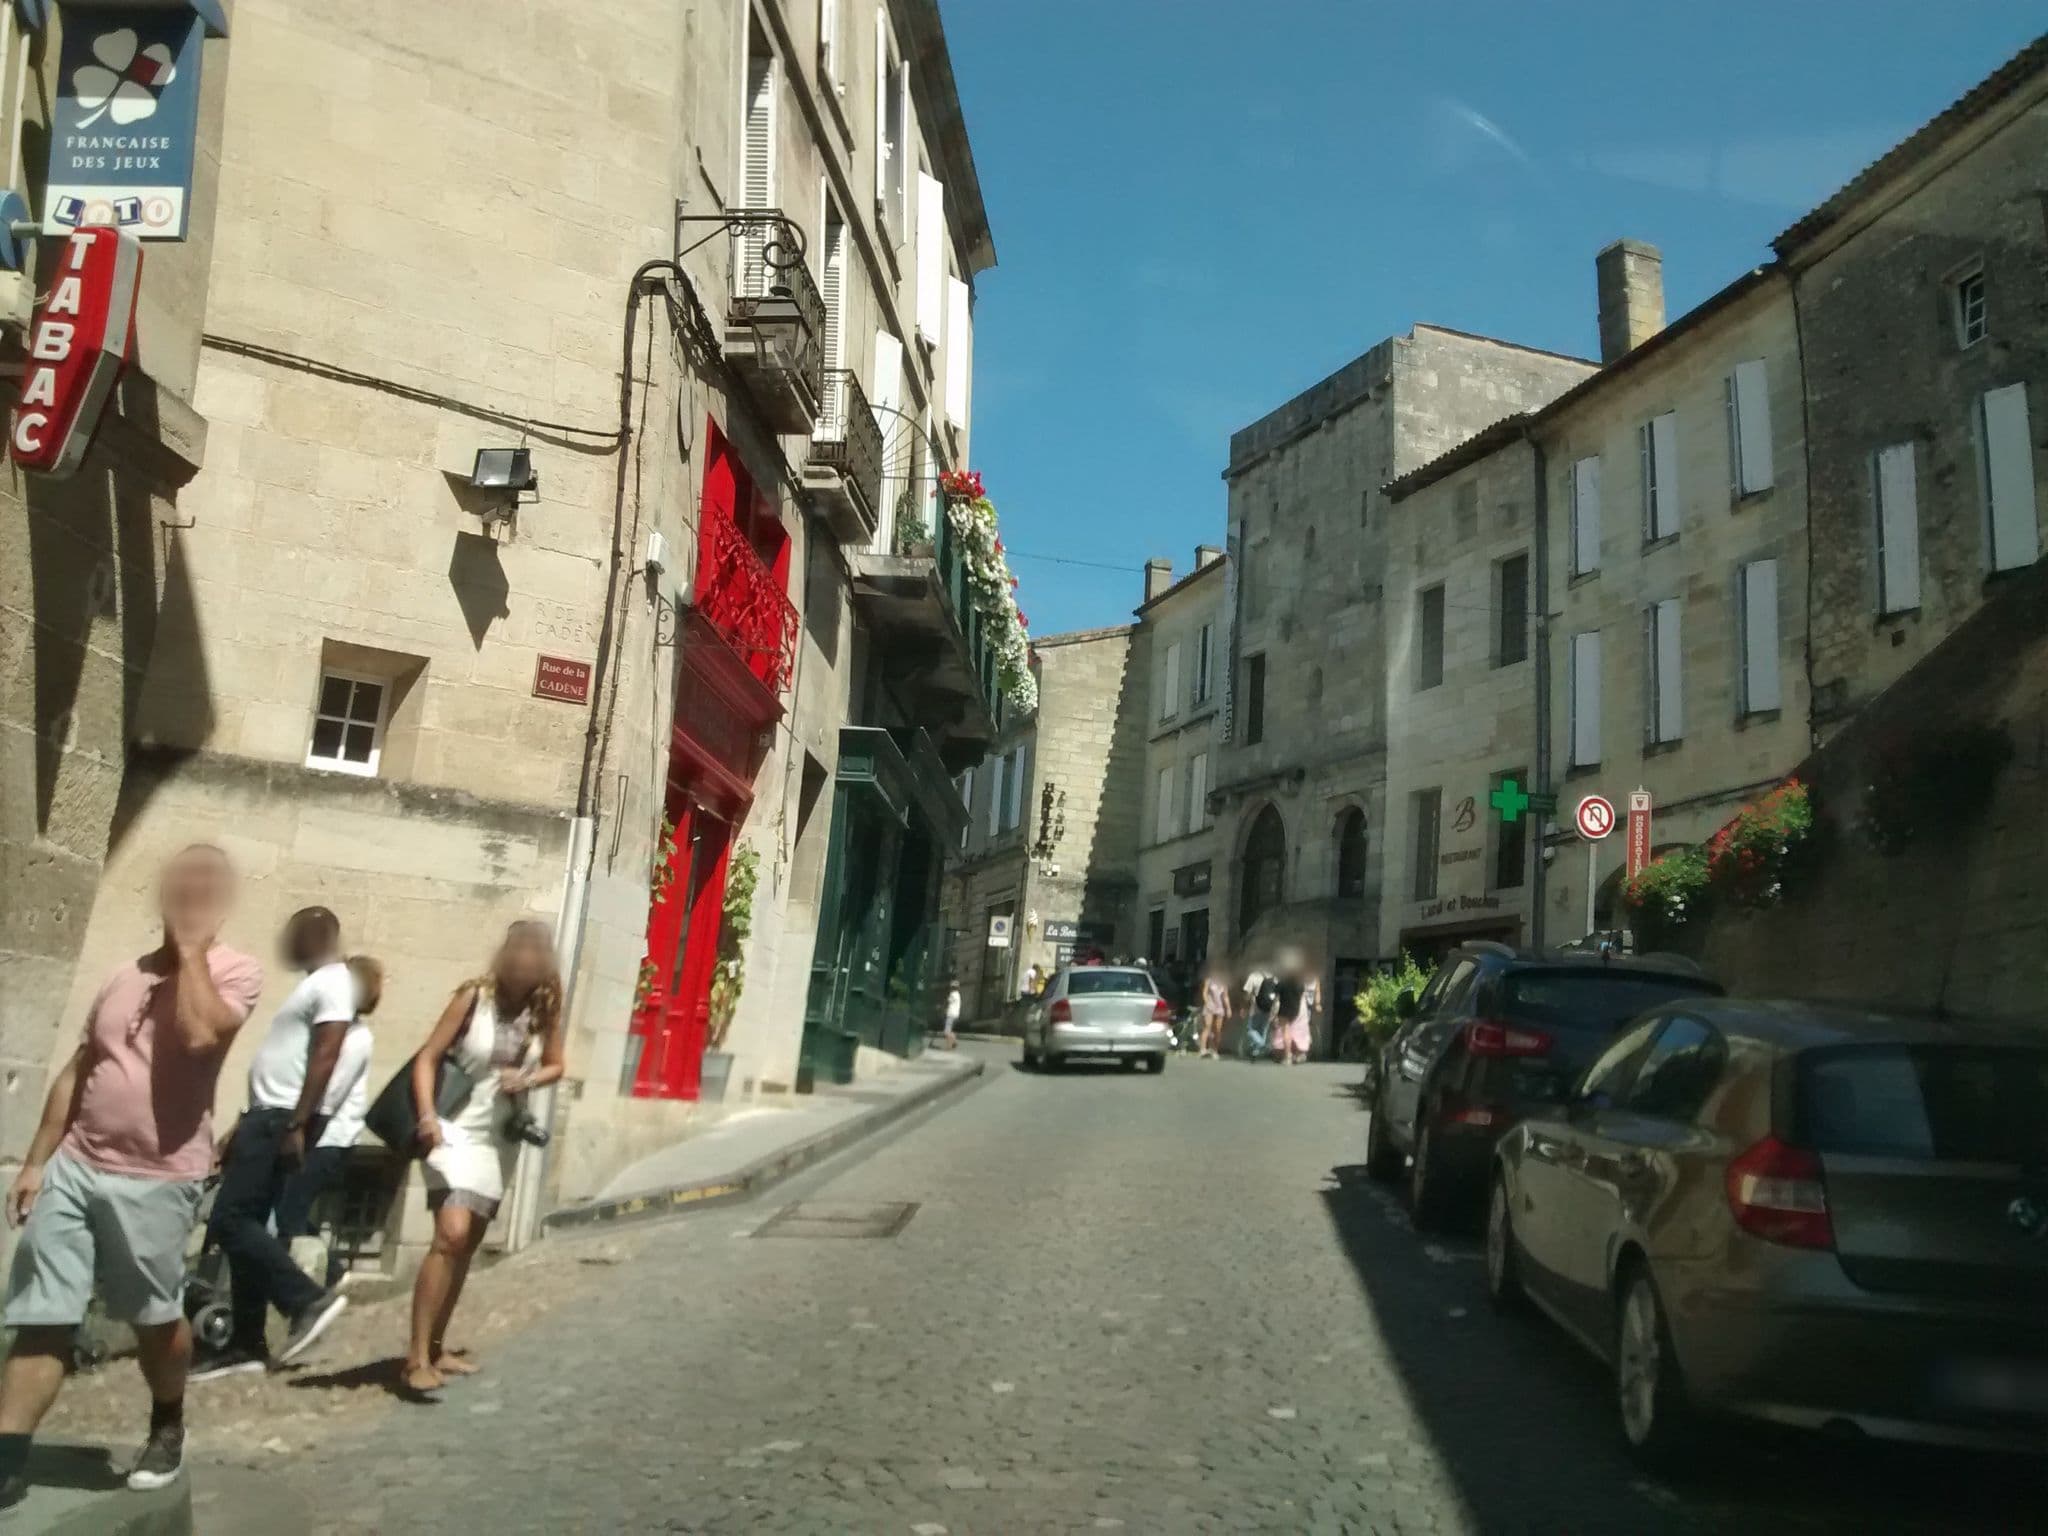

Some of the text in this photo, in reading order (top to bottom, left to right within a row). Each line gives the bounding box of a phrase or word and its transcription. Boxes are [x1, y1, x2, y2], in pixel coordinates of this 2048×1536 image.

[66, 135, 171, 150] FRANCAISE
[72, 155, 161, 171] DES JEUX
[54, 195, 172, 226] LOTO
[15, 232, 97, 454] TABAC
[542, 661, 585, 679] Rue de la
